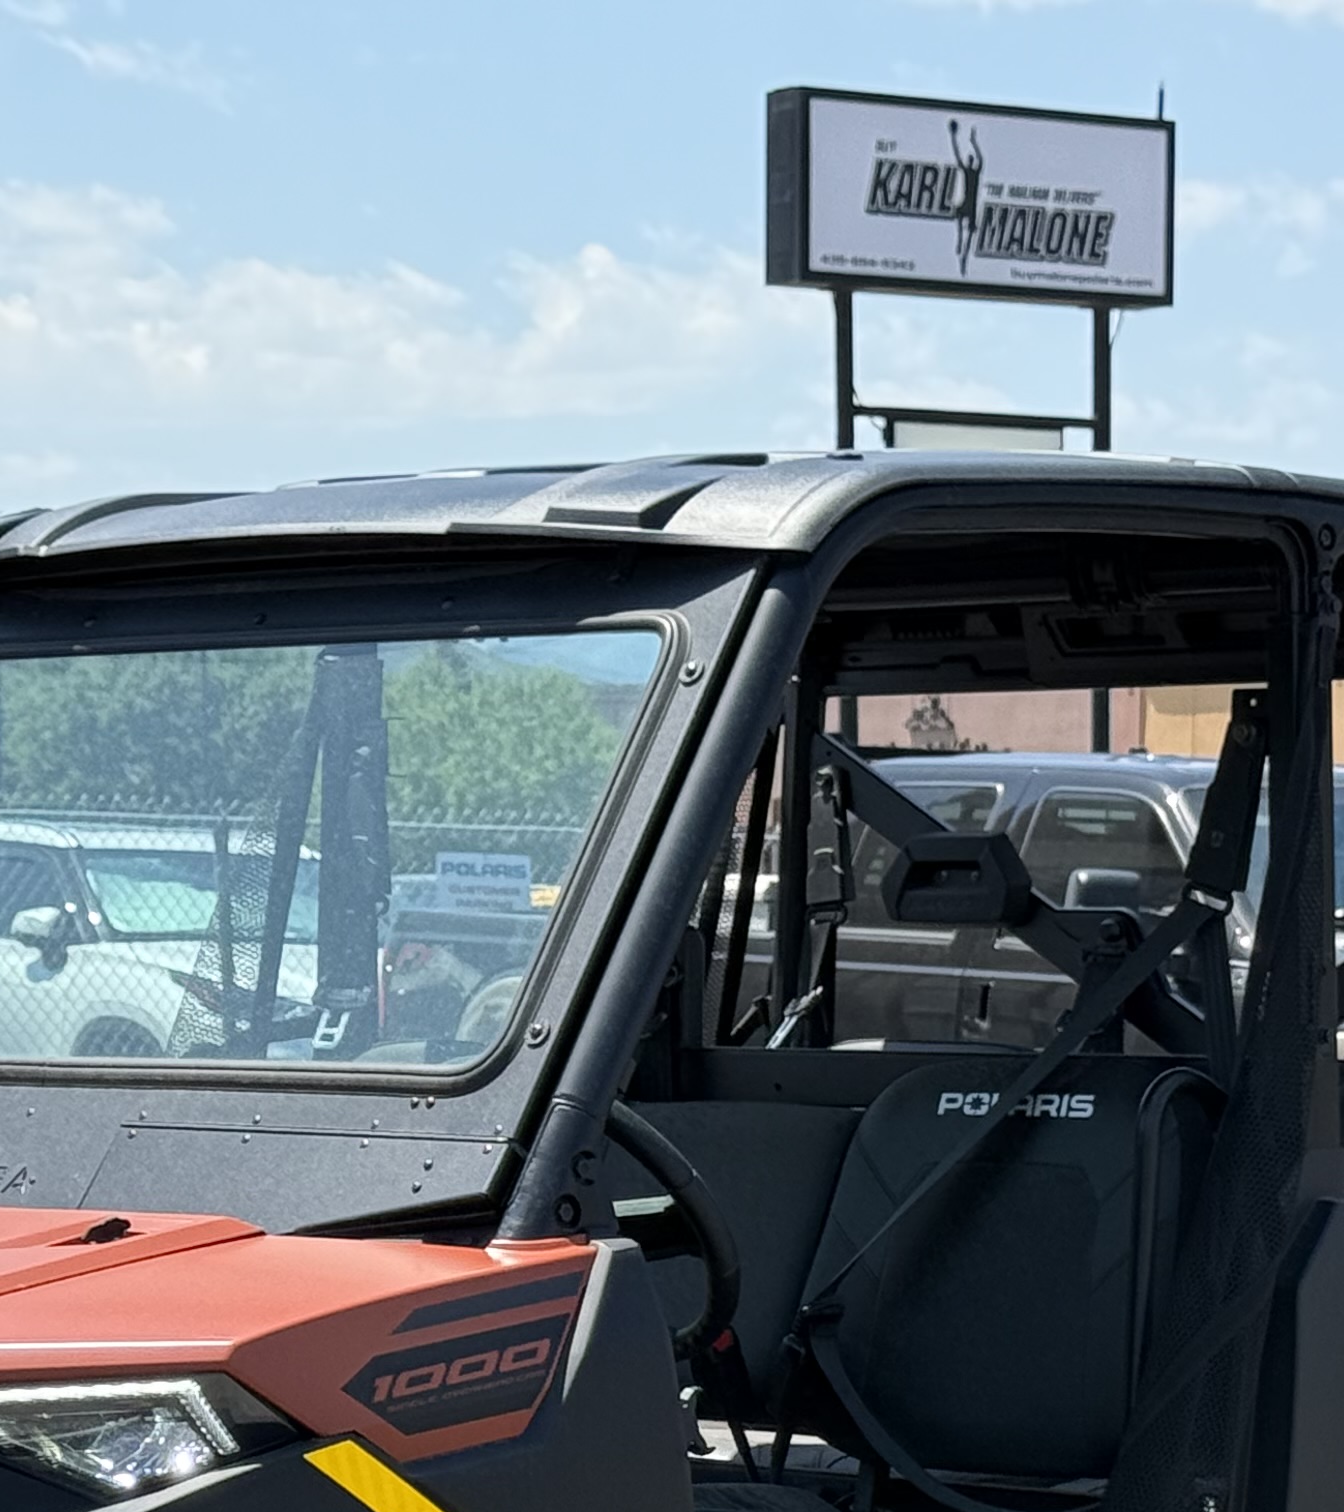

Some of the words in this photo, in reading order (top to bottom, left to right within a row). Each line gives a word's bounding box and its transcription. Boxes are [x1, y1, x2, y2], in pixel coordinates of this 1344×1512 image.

[865, 158, 957, 220] KARL
[975, 202, 1115, 266] MALONE
[440, 862, 526, 879] POLARIS
[372, 1338, 551, 1404] 1000
